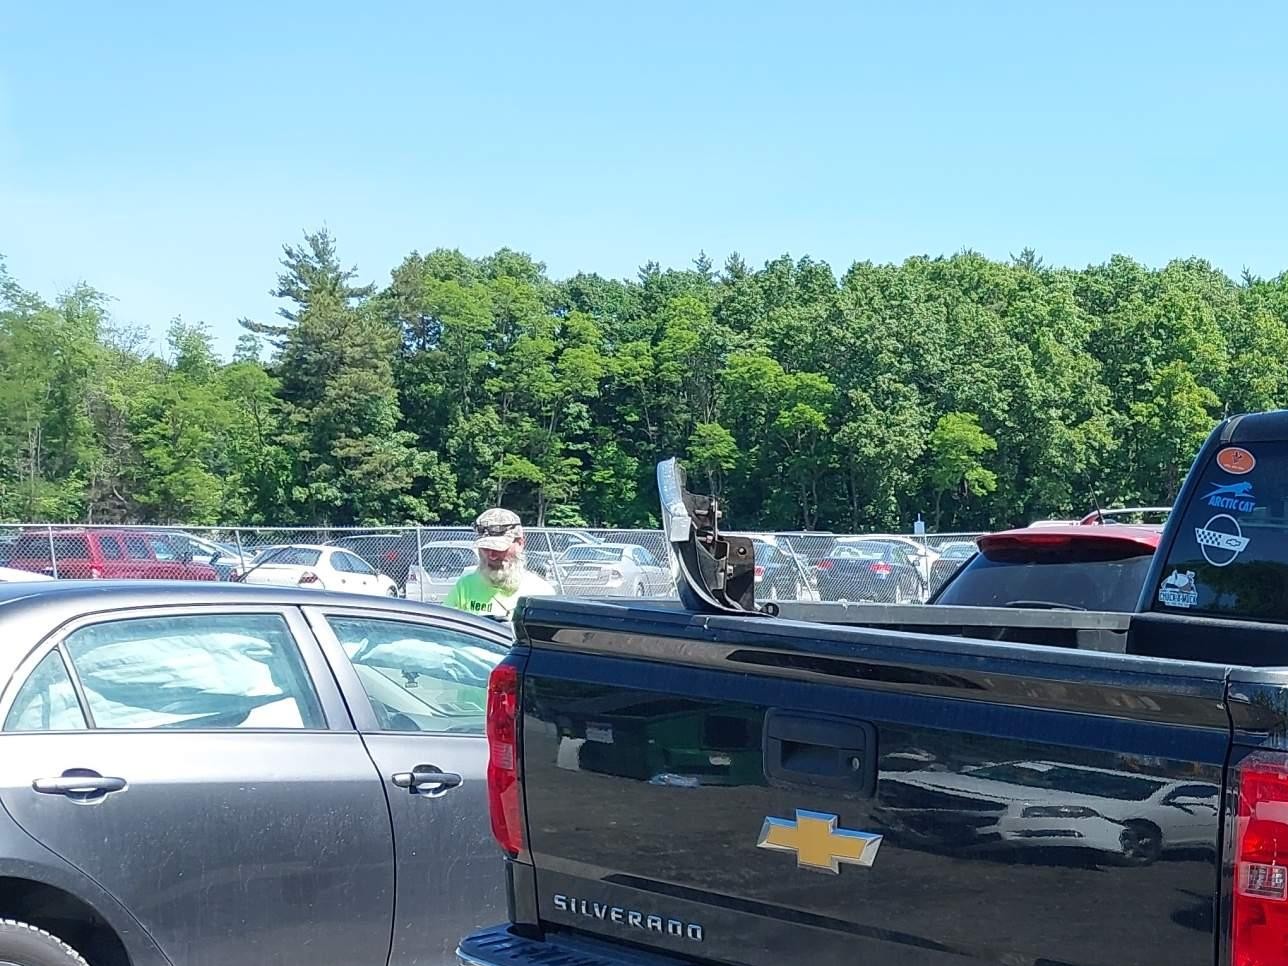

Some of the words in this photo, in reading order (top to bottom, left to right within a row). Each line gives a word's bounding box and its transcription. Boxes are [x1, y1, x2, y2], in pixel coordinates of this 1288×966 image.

[1208, 496, 1239, 510] ARCTIC
[1238, 500, 1256, 513] CAT
[470, 600, 493, 612] Need
[553, 894, 704, 942] SILVERADO
